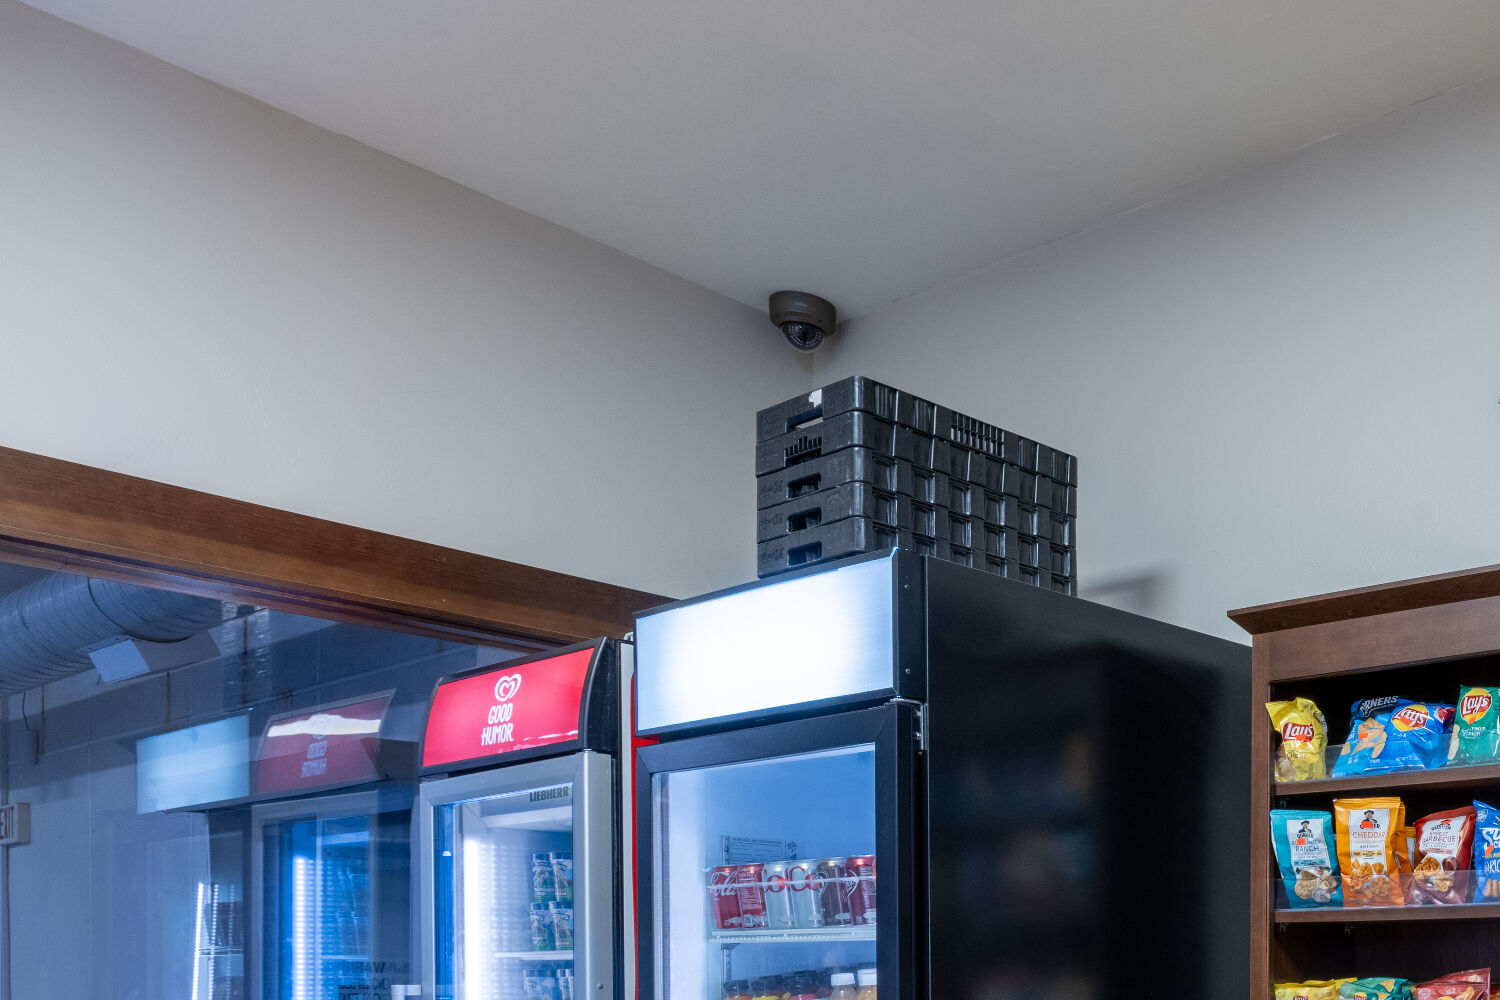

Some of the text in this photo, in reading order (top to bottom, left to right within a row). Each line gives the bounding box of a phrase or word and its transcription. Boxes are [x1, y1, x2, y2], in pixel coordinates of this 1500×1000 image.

[488, 702, 514, 724] GOOD
[1462, 695, 1491, 715] Lay's
[481, 723, 514, 746] HUMOR
[1285, 722, 1314, 741] Lay's
[529, 786, 570, 802] LIEBHERR
